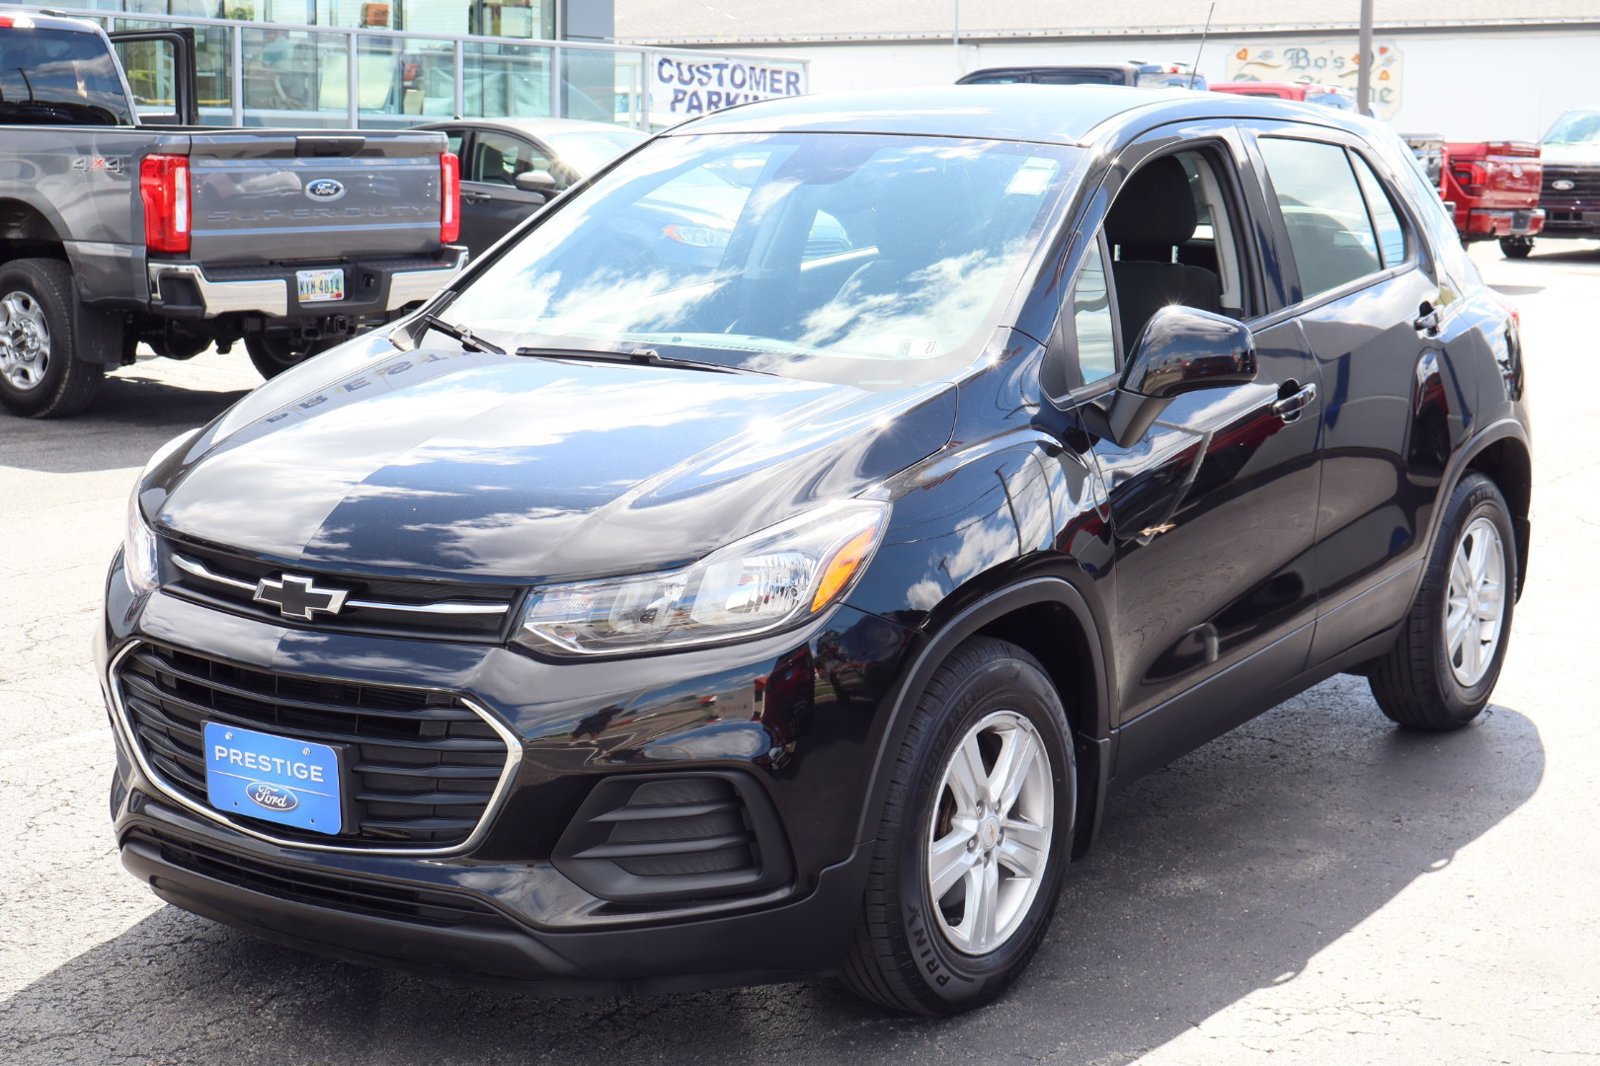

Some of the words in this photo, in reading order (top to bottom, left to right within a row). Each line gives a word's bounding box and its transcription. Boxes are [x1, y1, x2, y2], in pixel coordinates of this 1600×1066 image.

[1283, 47, 1345, 70] Bo's
[657, 57, 801, 96] CUSTOMER
[670, 88, 768, 114] PARK
[208, 207, 336, 222] SUPER
[344, 205, 430, 218] DUTY
[214, 745, 324, 783] PRESTIGE
[255, 784, 288, 808] Ford
[907, 904, 951, 987] PRINX
